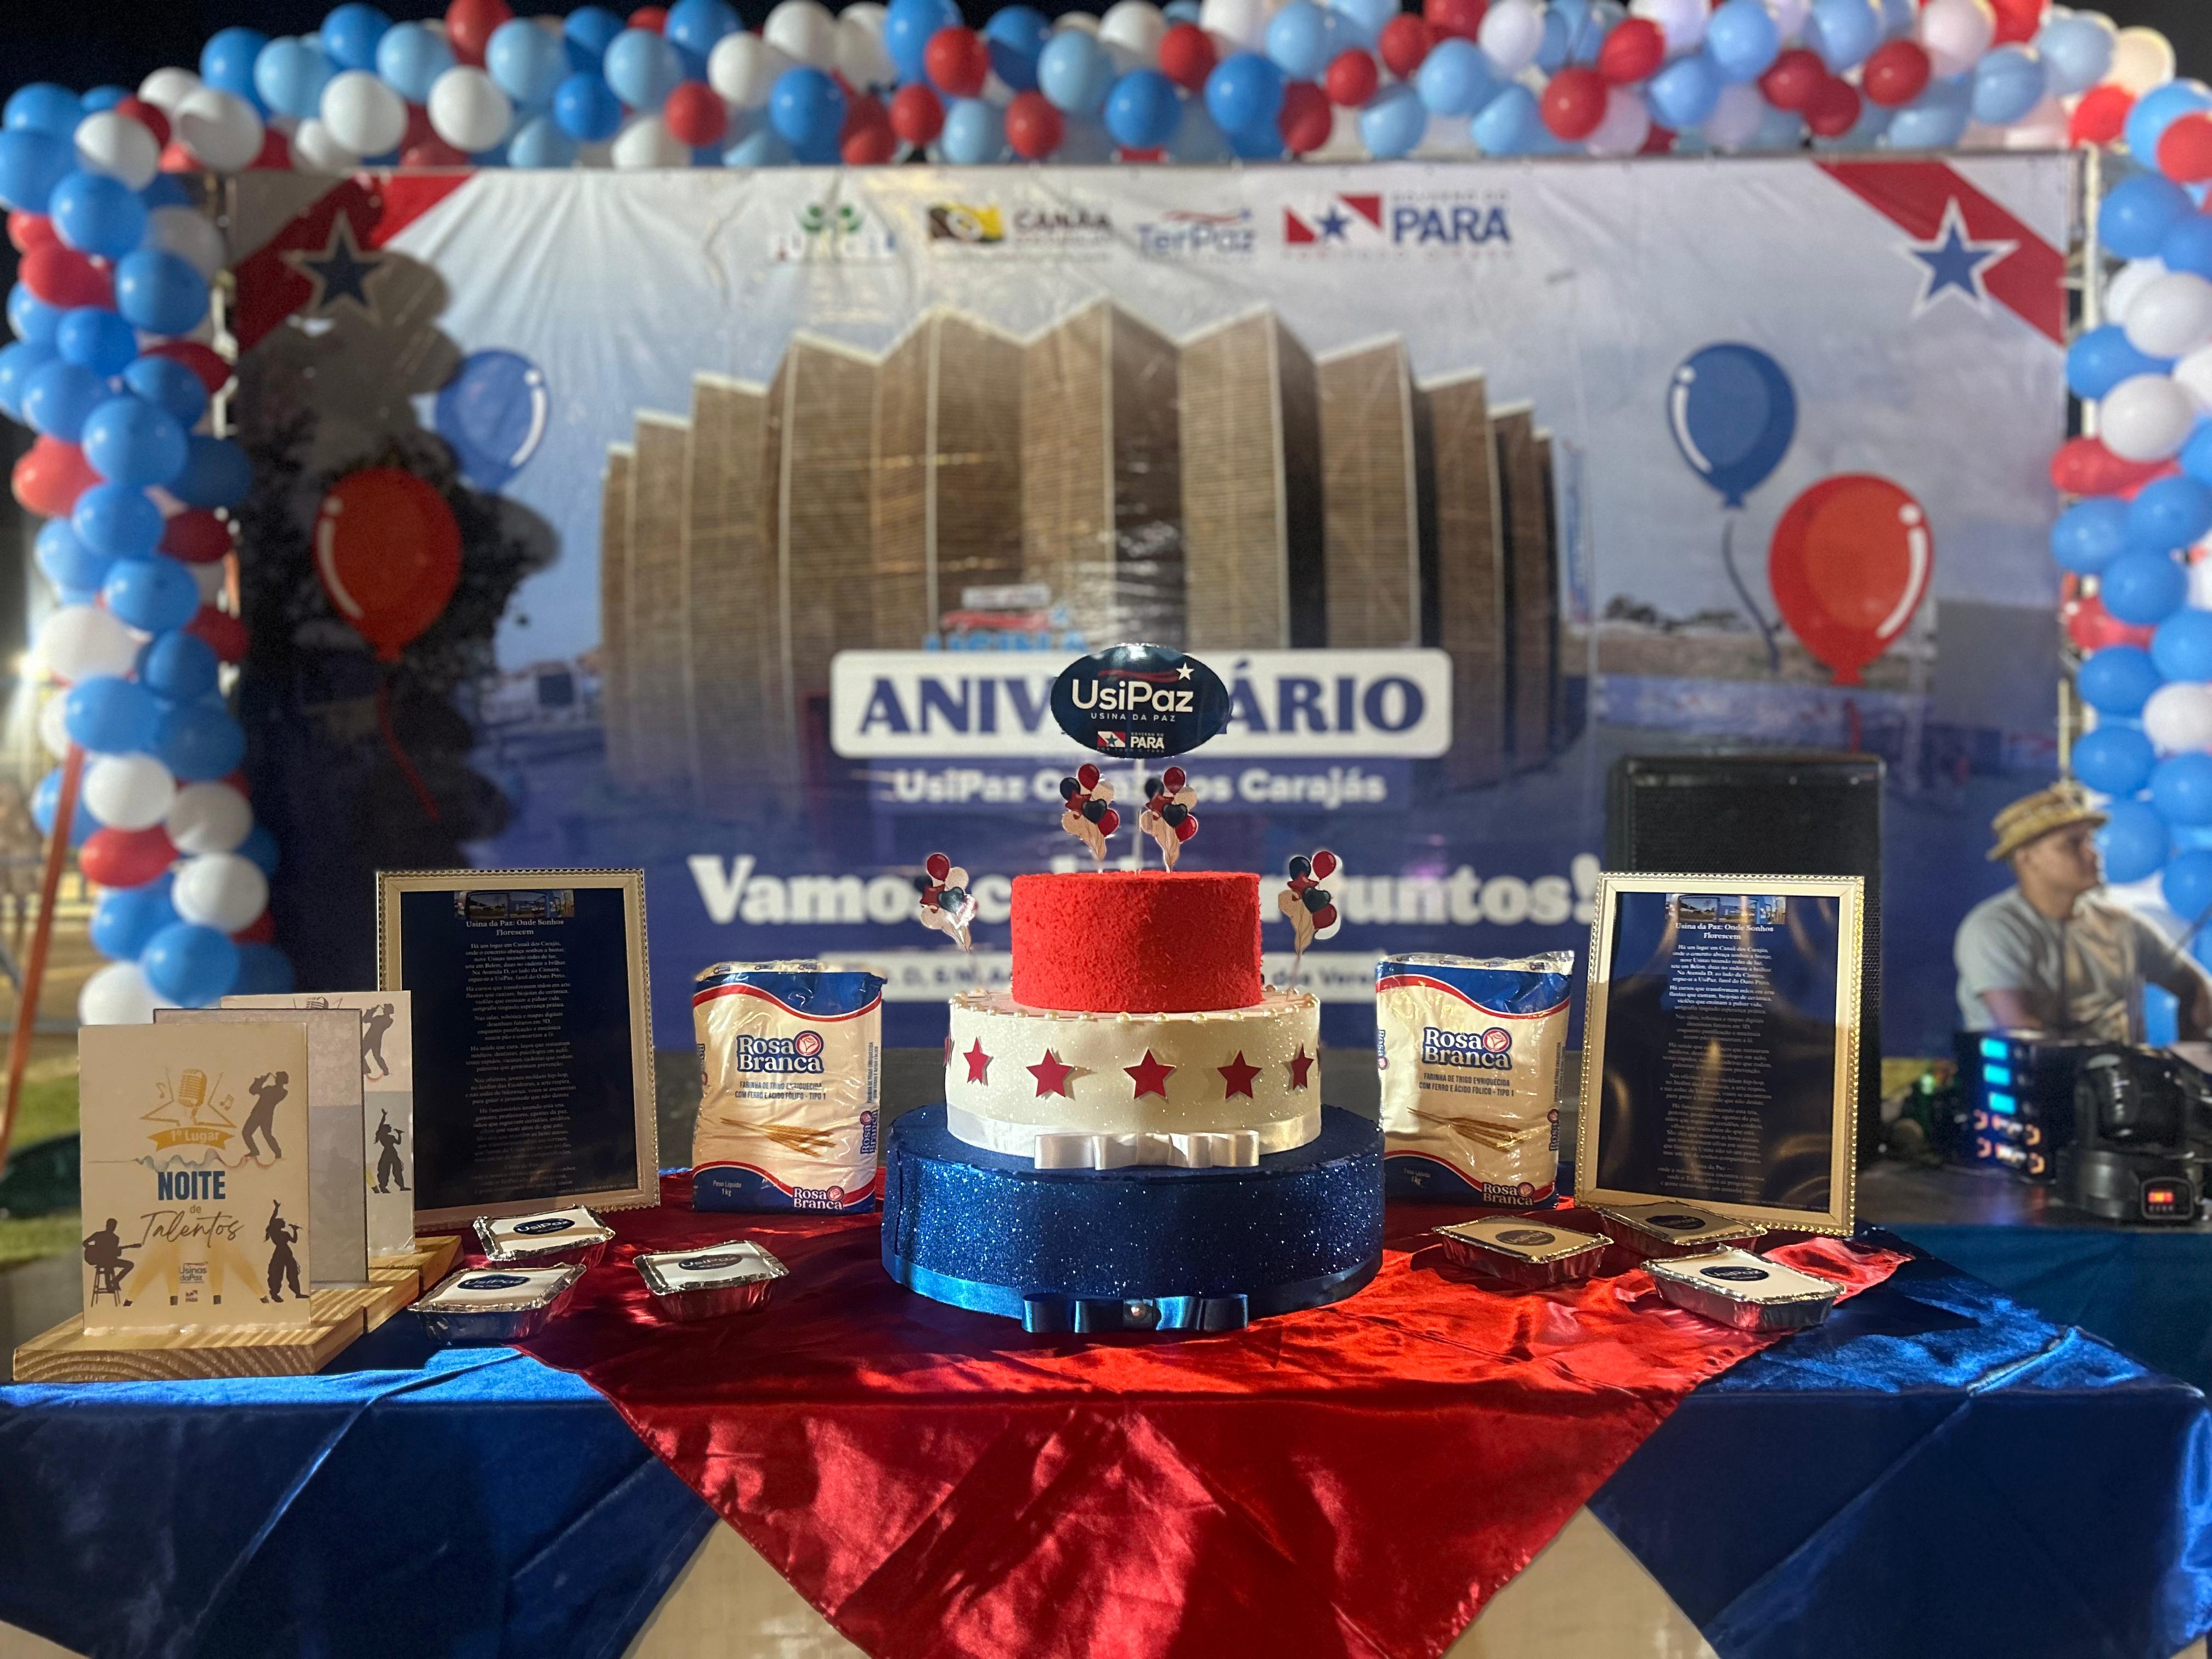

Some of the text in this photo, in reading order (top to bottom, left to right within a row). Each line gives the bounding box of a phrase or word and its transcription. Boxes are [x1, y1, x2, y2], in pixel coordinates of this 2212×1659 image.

[859, 660, 1425, 735] ANIVÁRIO
[1072, 679, 1194, 713] UsiPaz
[893, 767, 1025, 802] UsiPaz
[1239, 765, 1386, 809] Carajás
[739, 1037, 795, 1054] Rosa
[1425, 1029, 1482, 1049] Rosa
[740, 1054, 821, 1071] Branca
[1425, 1046, 1509, 1068] Branca
[1424, 1073, 1447, 1081] FARINHA
[185, 1130, 220, 1143] Lugar
[861, 1125, 871, 1153] Rosa
[157, 1170, 226, 1200] NOITE
[1483, 1183, 1517, 1196] Rosa
[794, 1188, 827, 1200] Rosa
[1483, 1193, 1533, 1205] Branca
[190, 1205, 202, 1214] de
[794, 1199, 843, 1210] Branca
[140, 1211, 245, 1249] Talentos
